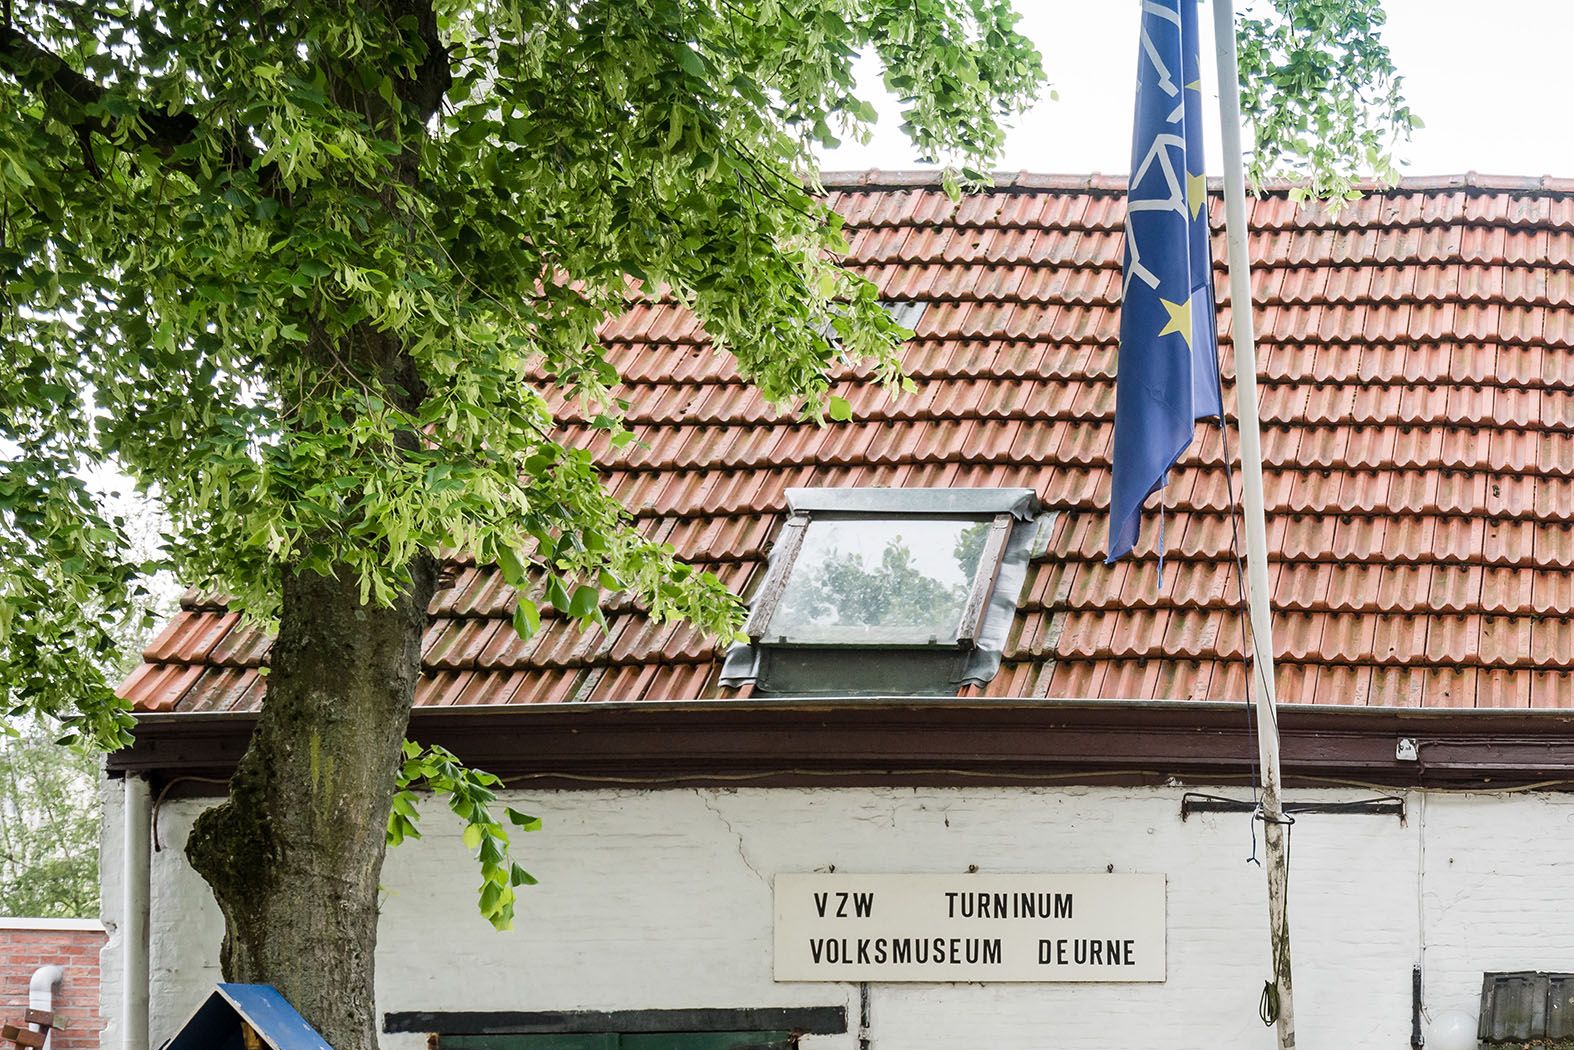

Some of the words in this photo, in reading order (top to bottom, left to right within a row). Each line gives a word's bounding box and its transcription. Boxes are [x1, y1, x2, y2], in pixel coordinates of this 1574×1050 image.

[813, 892, 874, 918] VZW
[945, 892, 1073, 919] TURNINUM
[809, 938, 1001, 964] VOLKSMUSEUM
[1038, 939, 1136, 965] DEURNE
